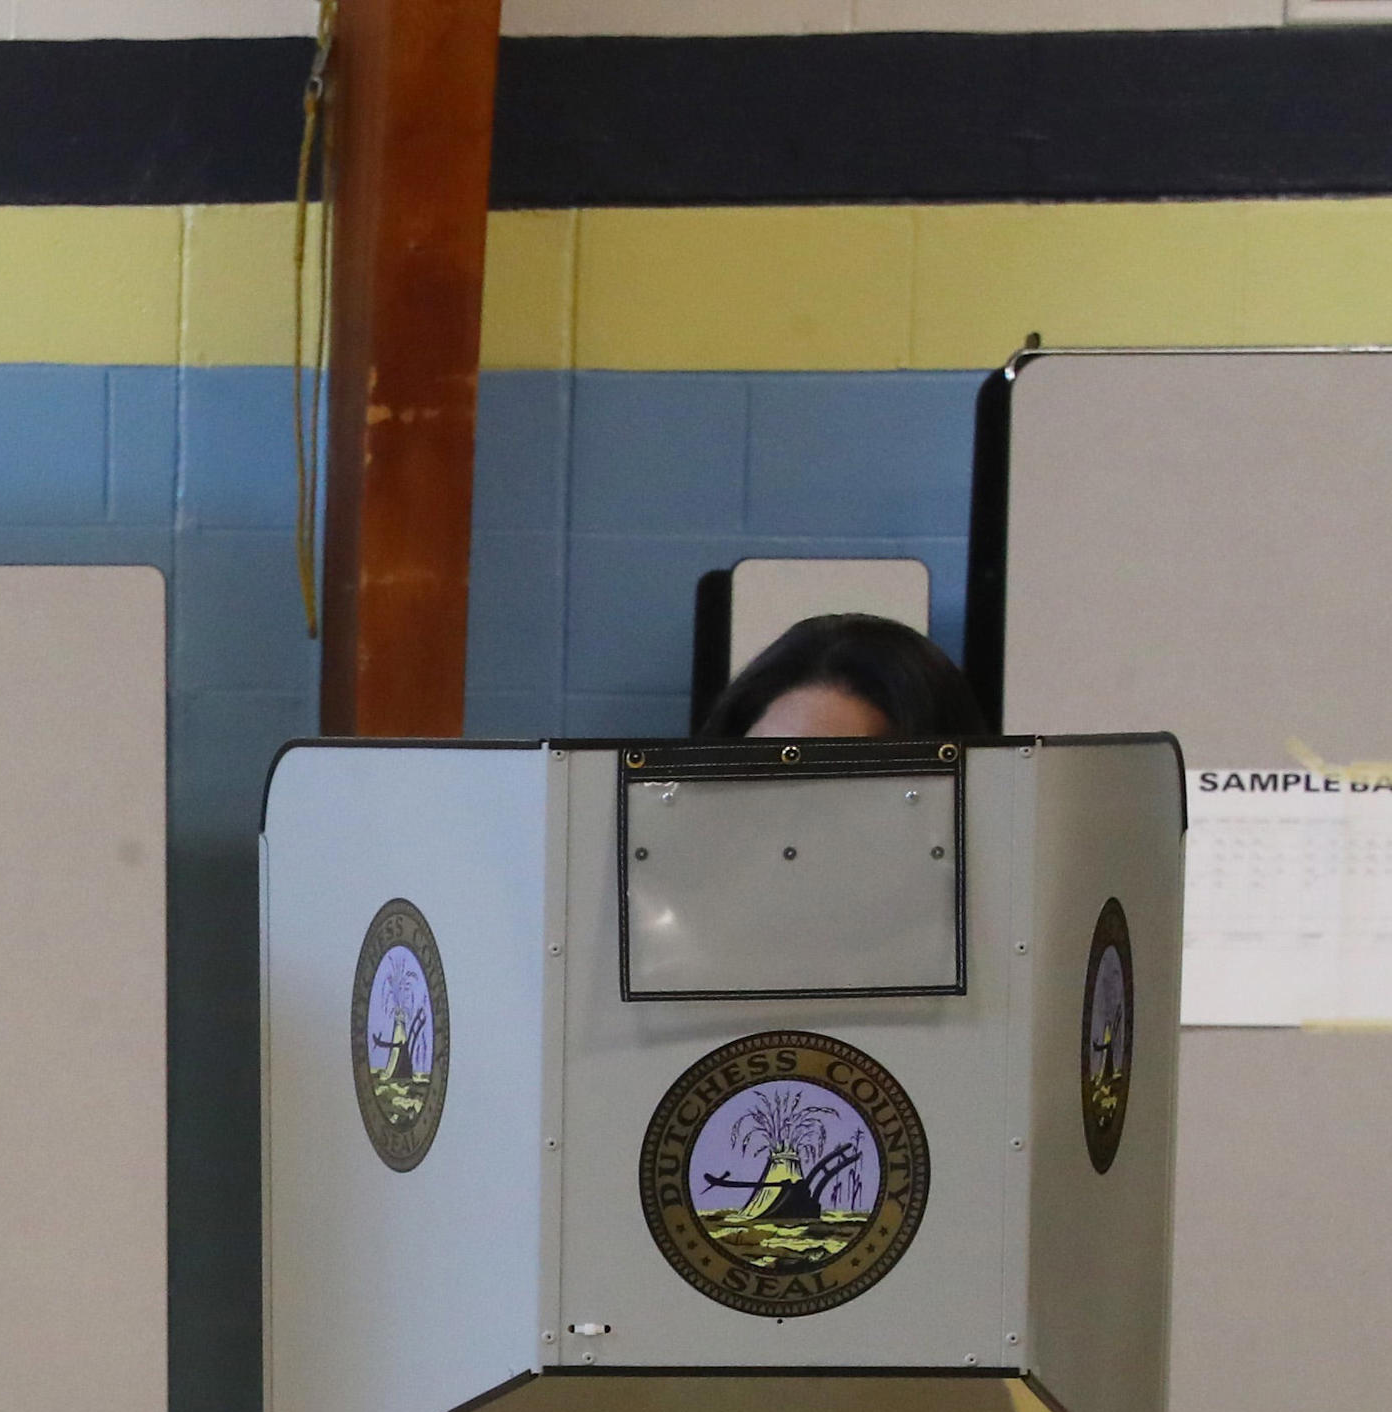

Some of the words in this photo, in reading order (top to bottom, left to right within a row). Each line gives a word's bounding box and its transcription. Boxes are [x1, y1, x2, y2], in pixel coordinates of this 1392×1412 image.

[1199, 772, 1341, 793] SAMPLE
[658, 1050, 798, 1207] DUTCHESS
[826, 1060, 913, 1214] COUNTY
[722, 1266, 839, 1299] SEAL
